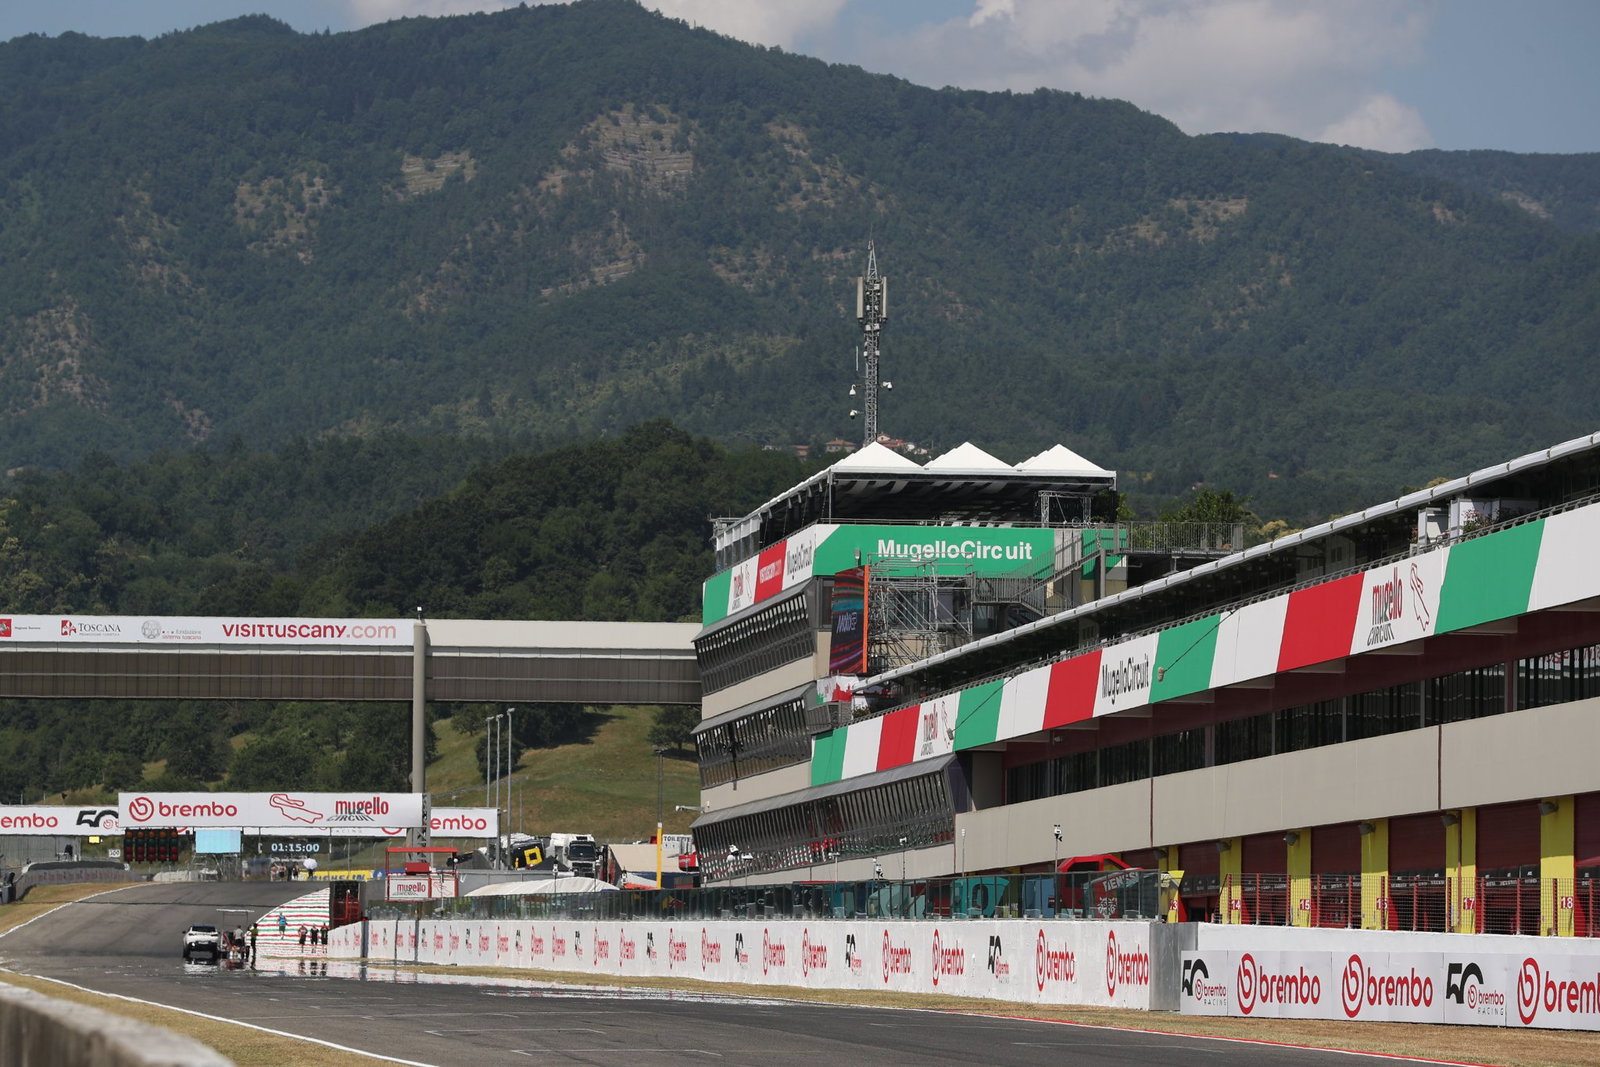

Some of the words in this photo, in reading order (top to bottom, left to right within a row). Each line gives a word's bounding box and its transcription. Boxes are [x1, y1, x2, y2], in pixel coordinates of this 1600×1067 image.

[877, 539, 1033, 562] MugelloCircuit
[1372, 566, 1403, 626] mugello
[1366, 622, 1395, 647] CIRCUIT
[1102, 653, 1149, 705] MugelloCircuit
[159, 801, 238, 818] brembo
[335, 796, 390, 815] mugello
[271, 842, 320, 852] 01:15:00
[397, 881, 427, 894] mugello
[940, 940, 965, 975] brembo
[1046, 941, 1075, 981] brembo
[1118, 944, 1149, 985] brembo
[1204, 983, 1227, 997] brembo
[1259, 965, 1321, 1005] brembo
[1367, 966, 1434, 1008] brembo
[1478, 989, 1505, 1006] brembo
[1544, 970, 1600, 1014] brem
[1477, 1006, 1505, 1016] RACING
